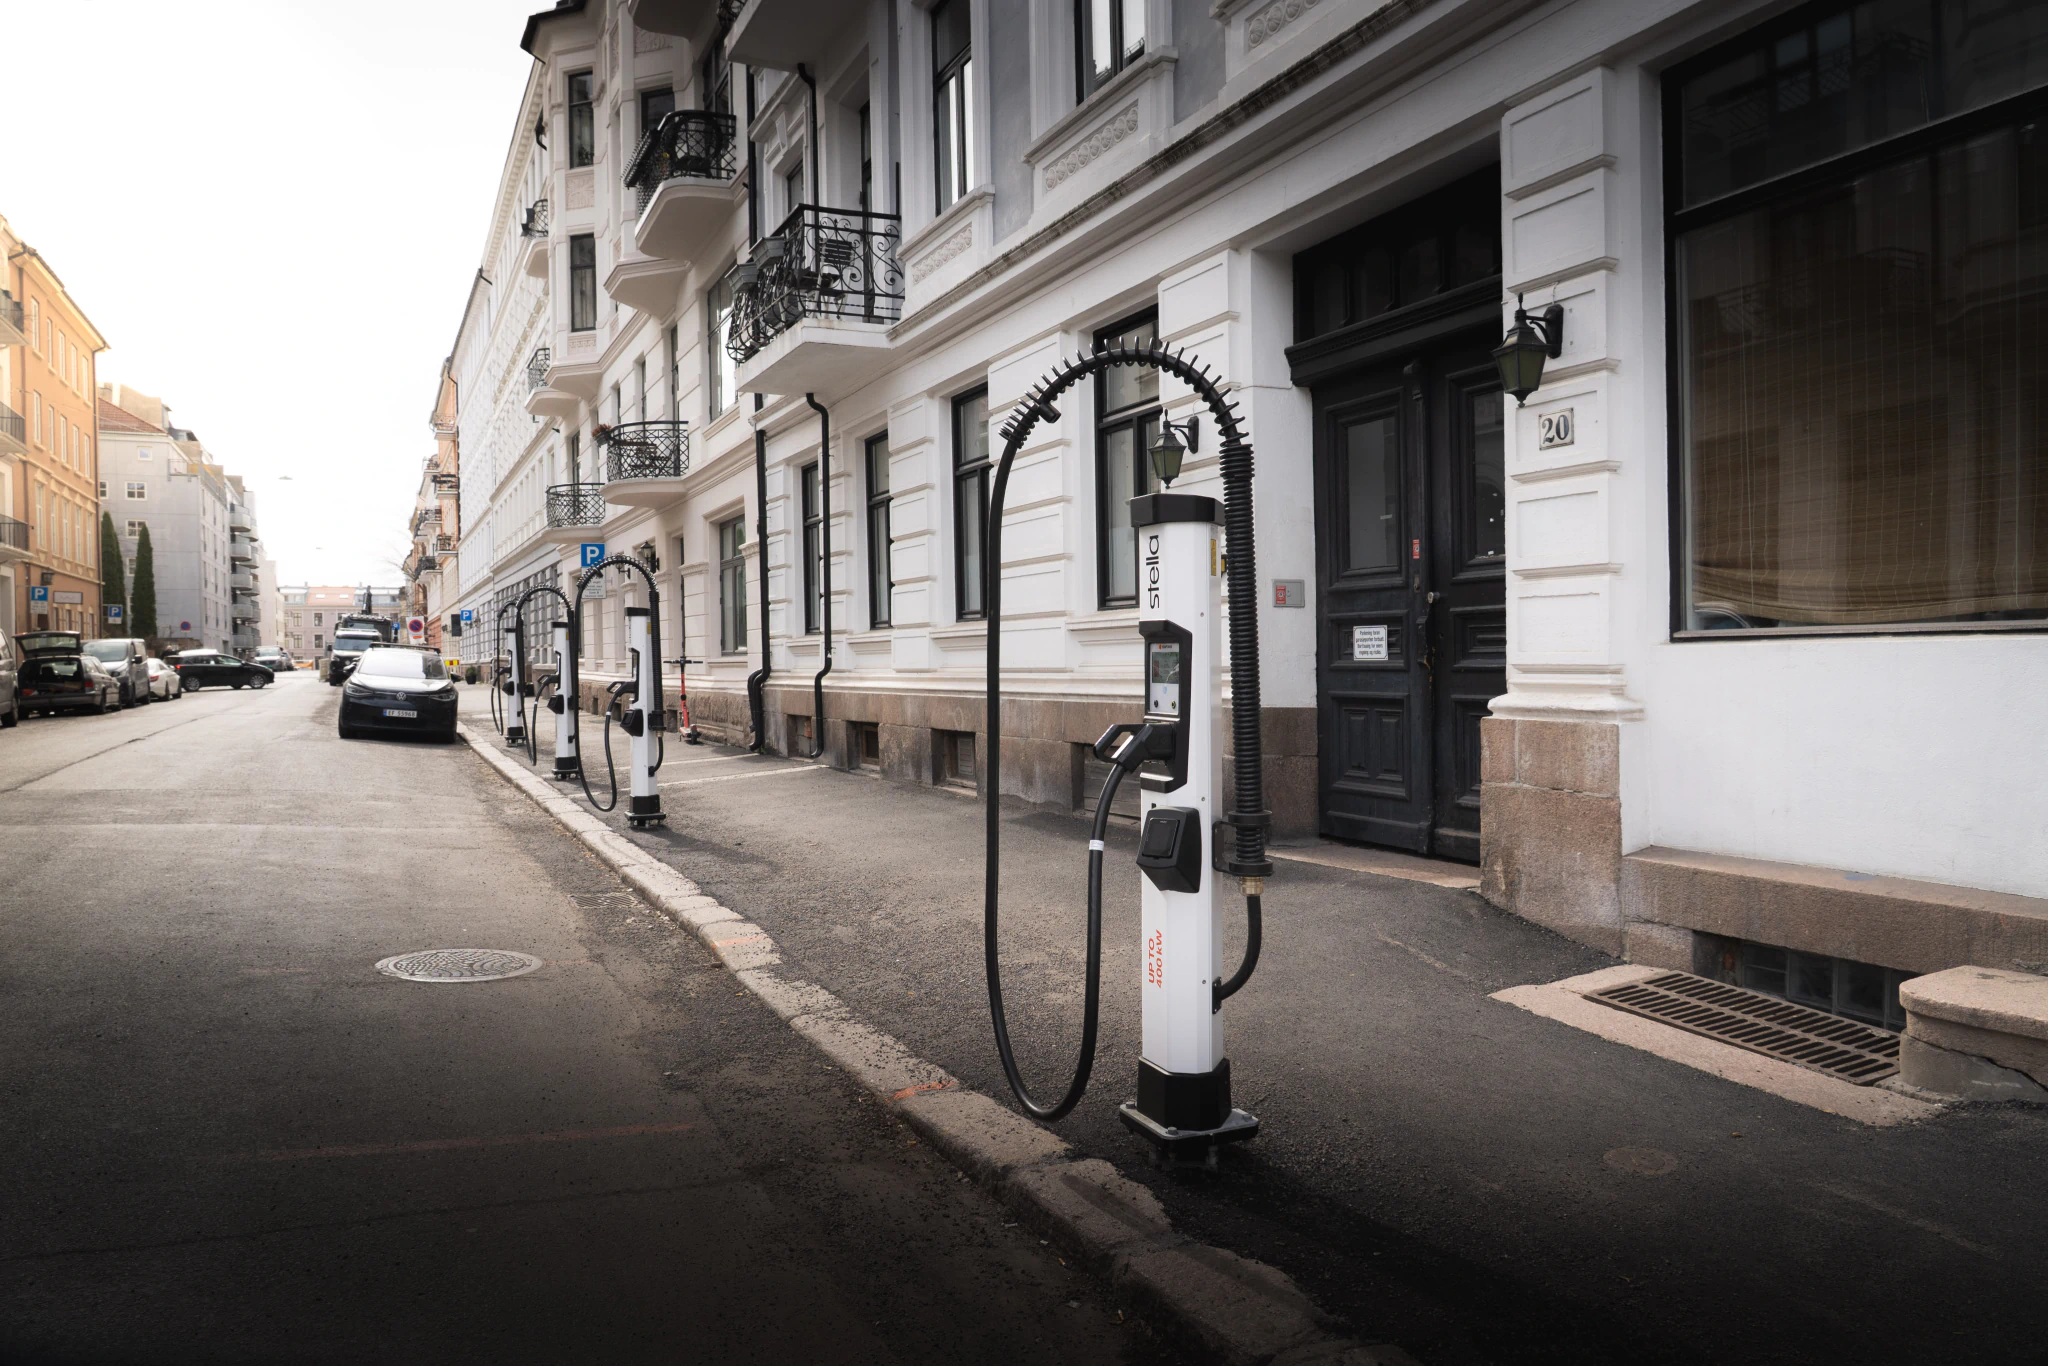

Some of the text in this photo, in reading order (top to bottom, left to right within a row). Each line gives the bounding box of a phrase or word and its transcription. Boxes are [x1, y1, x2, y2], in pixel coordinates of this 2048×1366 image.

[1541, 414, 1569, 444] 20
[586, 546, 600, 565] P
[1146, 534, 1160, 609] stella
[34, 588, 44, 599] P
[111, 607, 119, 616] P
[462, 611, 470, 619] P
[1148, 938, 1154, 984] UP TO
